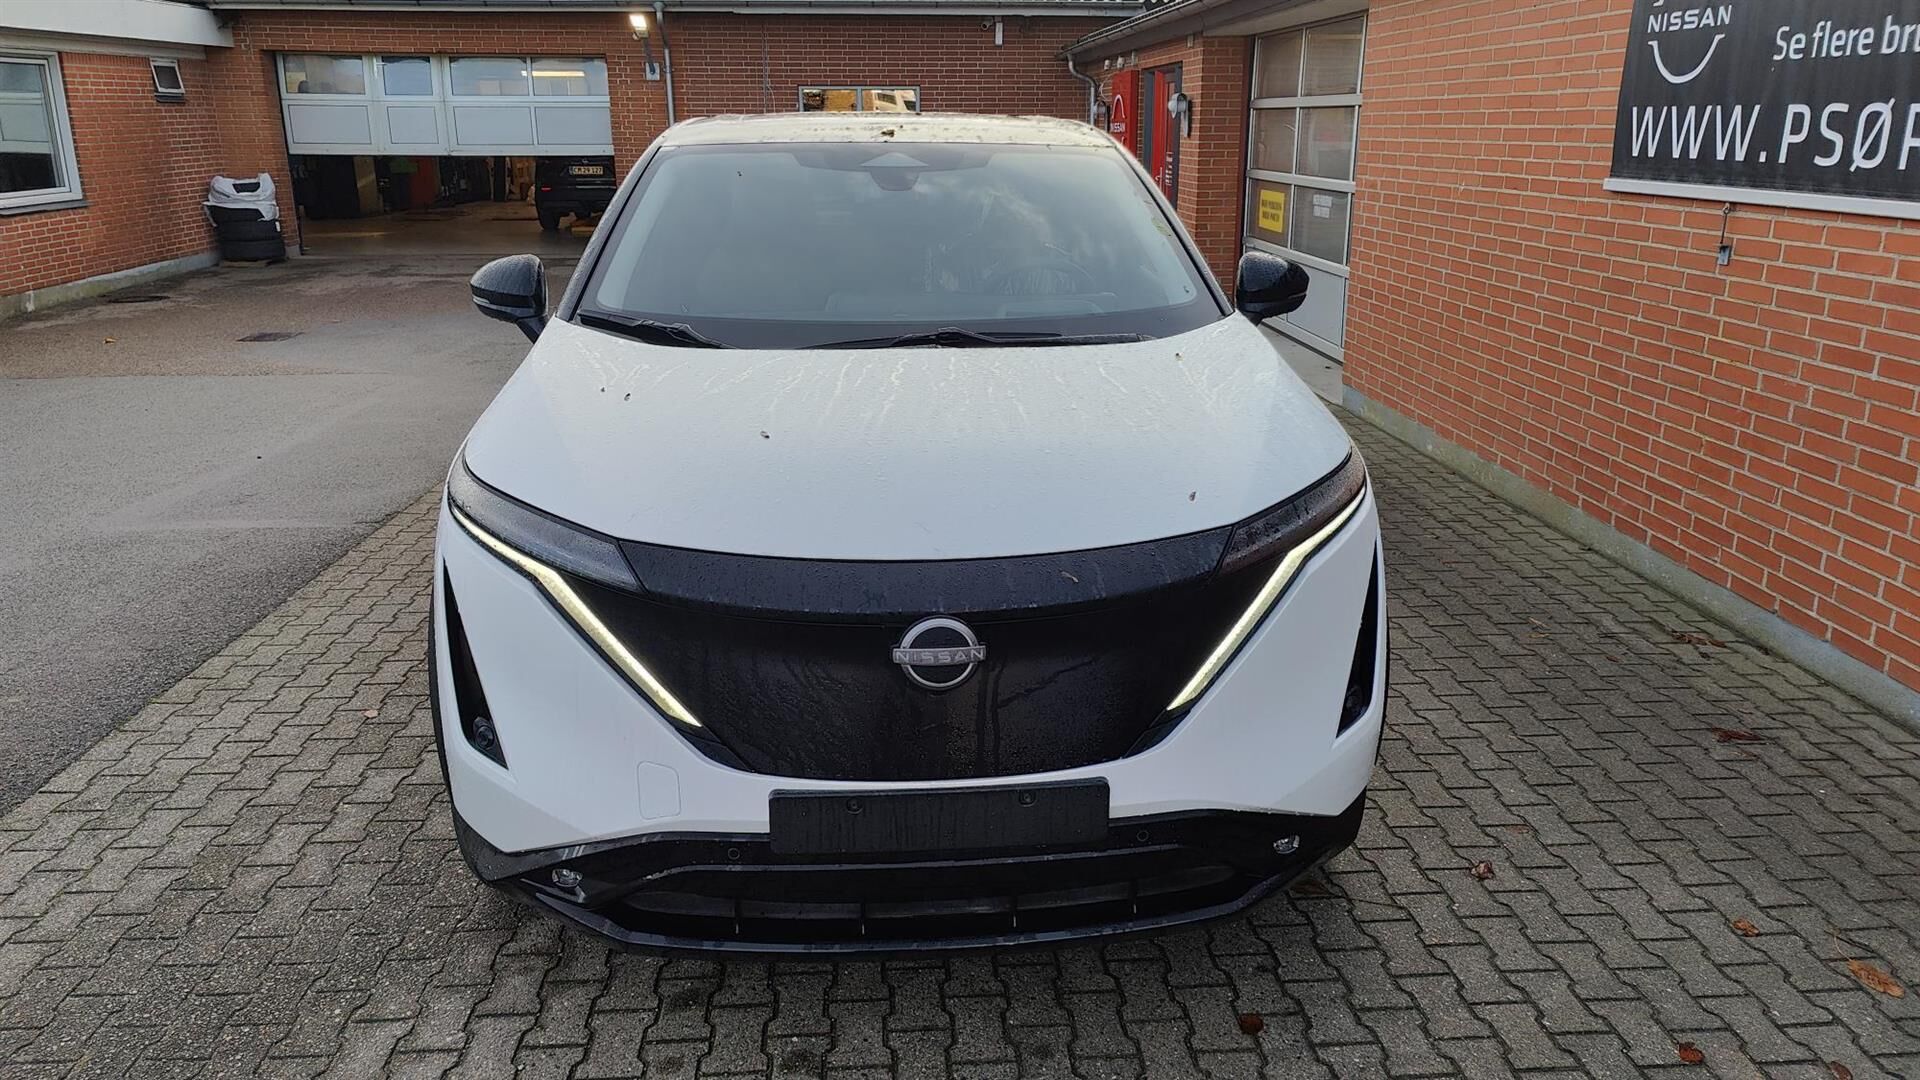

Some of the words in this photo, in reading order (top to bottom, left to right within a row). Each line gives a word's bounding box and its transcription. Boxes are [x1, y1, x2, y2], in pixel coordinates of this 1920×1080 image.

[1647, 4, 1732, 34] NISSAN
[1773, 26, 1806, 61] Se
[1811, 20, 1874, 58] flere
[896, 649, 984, 664] NISSAN
